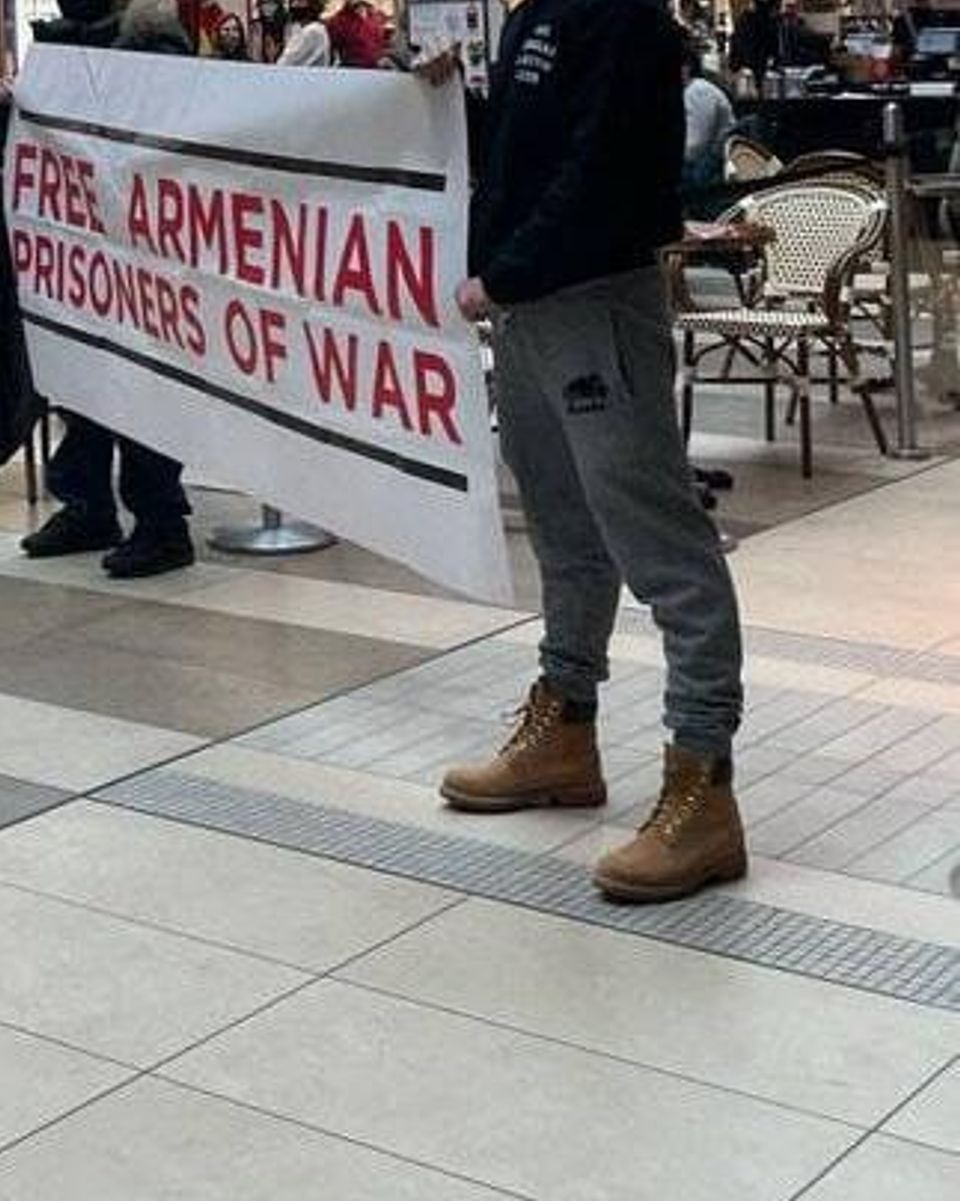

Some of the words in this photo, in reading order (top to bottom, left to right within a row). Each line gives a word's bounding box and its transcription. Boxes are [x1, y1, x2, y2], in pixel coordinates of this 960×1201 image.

[13, 143, 105, 233] FREE
[127, 172, 441, 328] ARMENIAN
[13, 229, 207, 357] PRISONERS
[224, 298, 288, 384] OF
[304, 320, 464, 446] WAR
